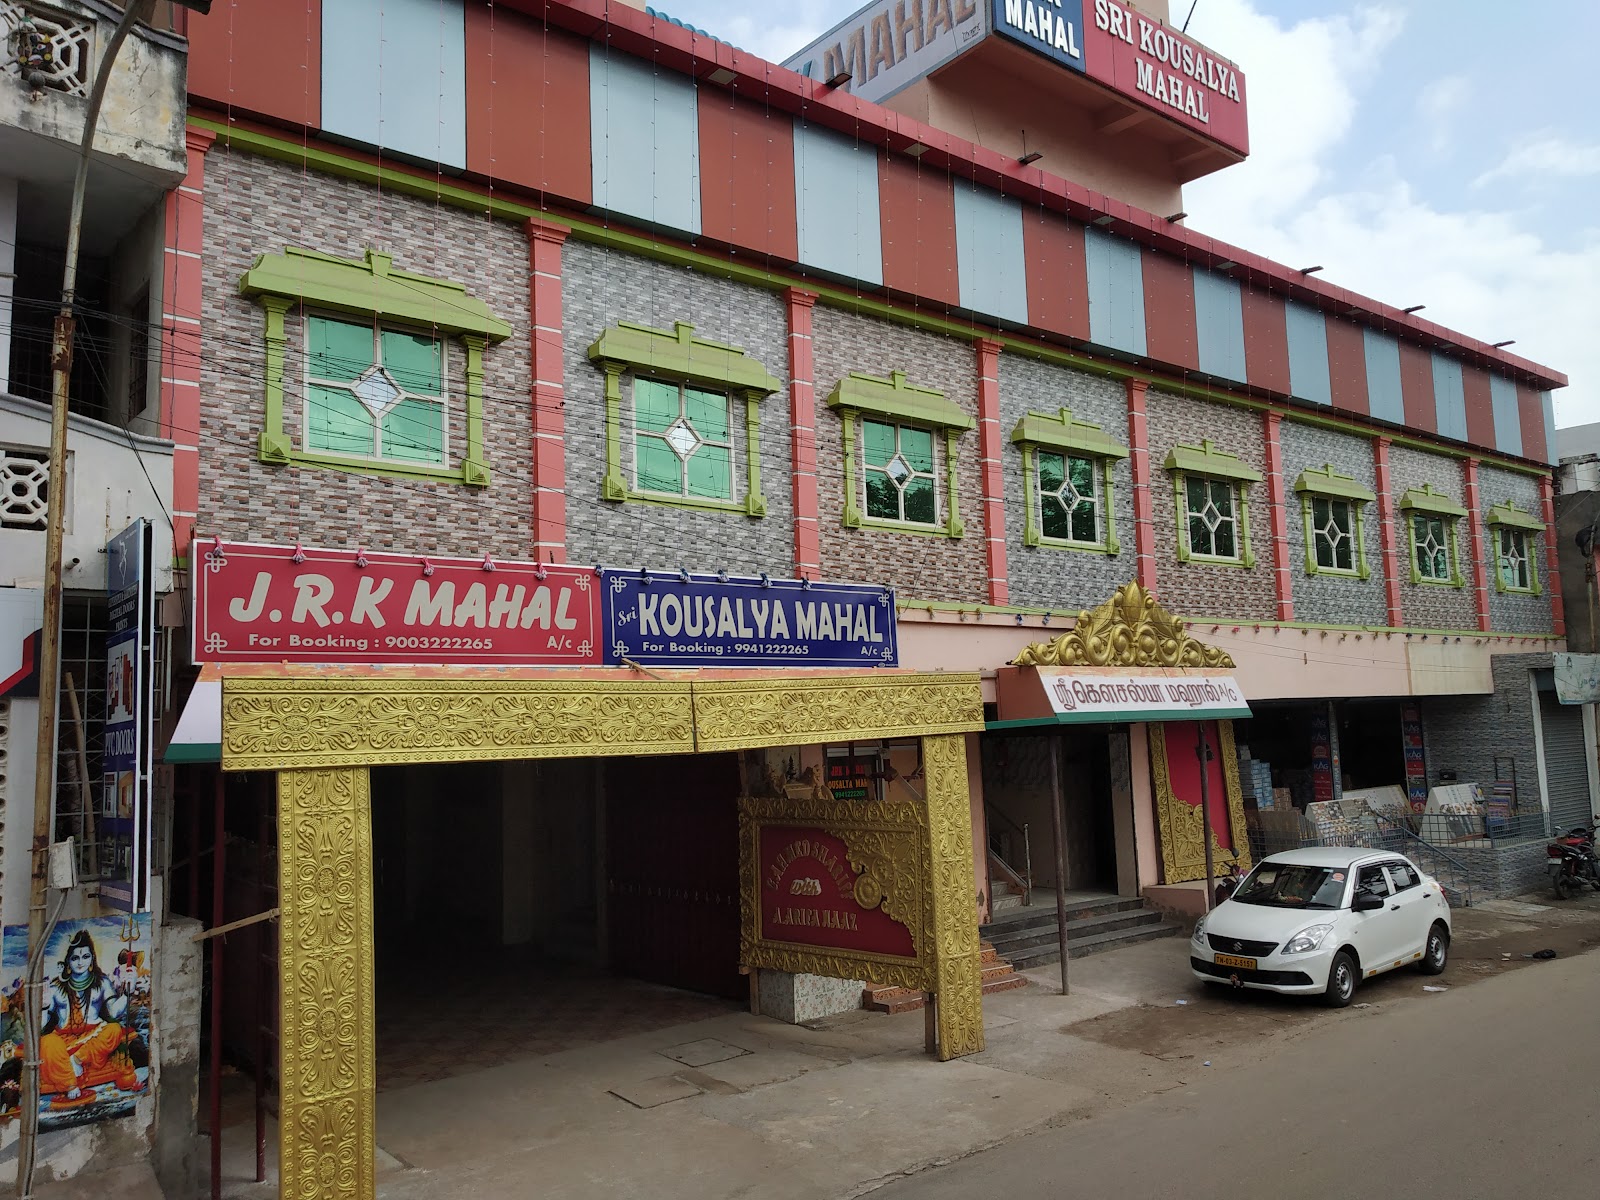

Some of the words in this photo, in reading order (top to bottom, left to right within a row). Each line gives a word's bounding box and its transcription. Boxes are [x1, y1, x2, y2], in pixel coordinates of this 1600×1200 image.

[1005, 0, 1080, 59] MAHAL
[1095, 1, 1134, 45] SRI
[1138, 18, 1241, 103] KOUSALYA
[1136, 57, 1209, 124] MAHAL
[229, 571, 394, 629] J.R.K
[403, 579, 577, 630] MAHAL
[617, 606, 638, 627] Sri
[638, 592, 790, 640] KOUSALYA
[795, 601, 883, 643] MAHAL
[249, 633, 281, 647] For
[289, 634, 368, 651] Booking
[385, 636, 493, 650] 9003222265
[546, 635, 573, 651] A/c
[642, 641, 664, 652] For
[669, 642, 723, 655] Booking
[735, 643, 809, 655] 9941222265
[104, 731, 116, 757] PVC
[115, 727, 135, 756] DOORS
